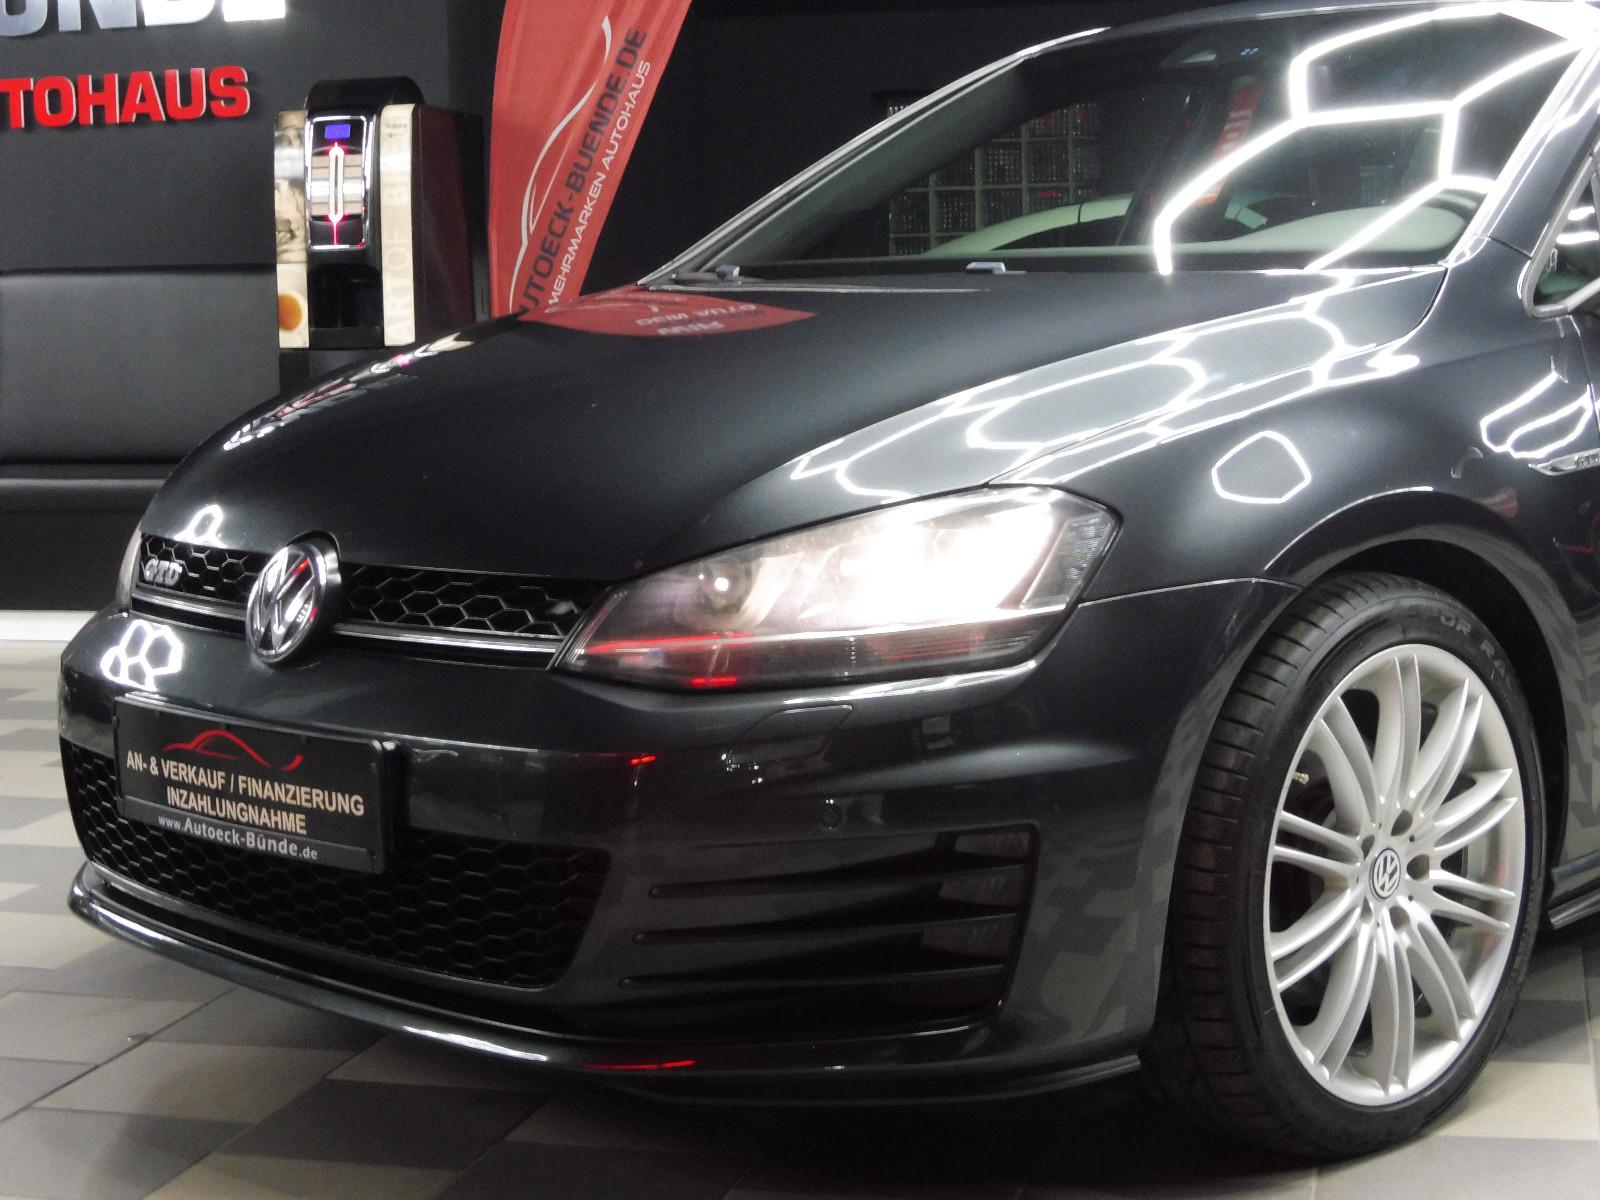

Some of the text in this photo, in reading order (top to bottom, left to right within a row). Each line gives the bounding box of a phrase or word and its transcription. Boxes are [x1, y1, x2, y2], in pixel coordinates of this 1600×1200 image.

[518, 26, 648, 315] UTOECK-BUENDE.DE
[548, 60, 651, 305] MEHRMARKEN AUTOHAUS
[126, 750, 365, 817] AN- & VERKAUF / FINANZIERUNG
[166, 786, 308, 836] INZAHLUNGNAHME
[158, 815, 318, 861] www.Autoeck-Bünde.de
